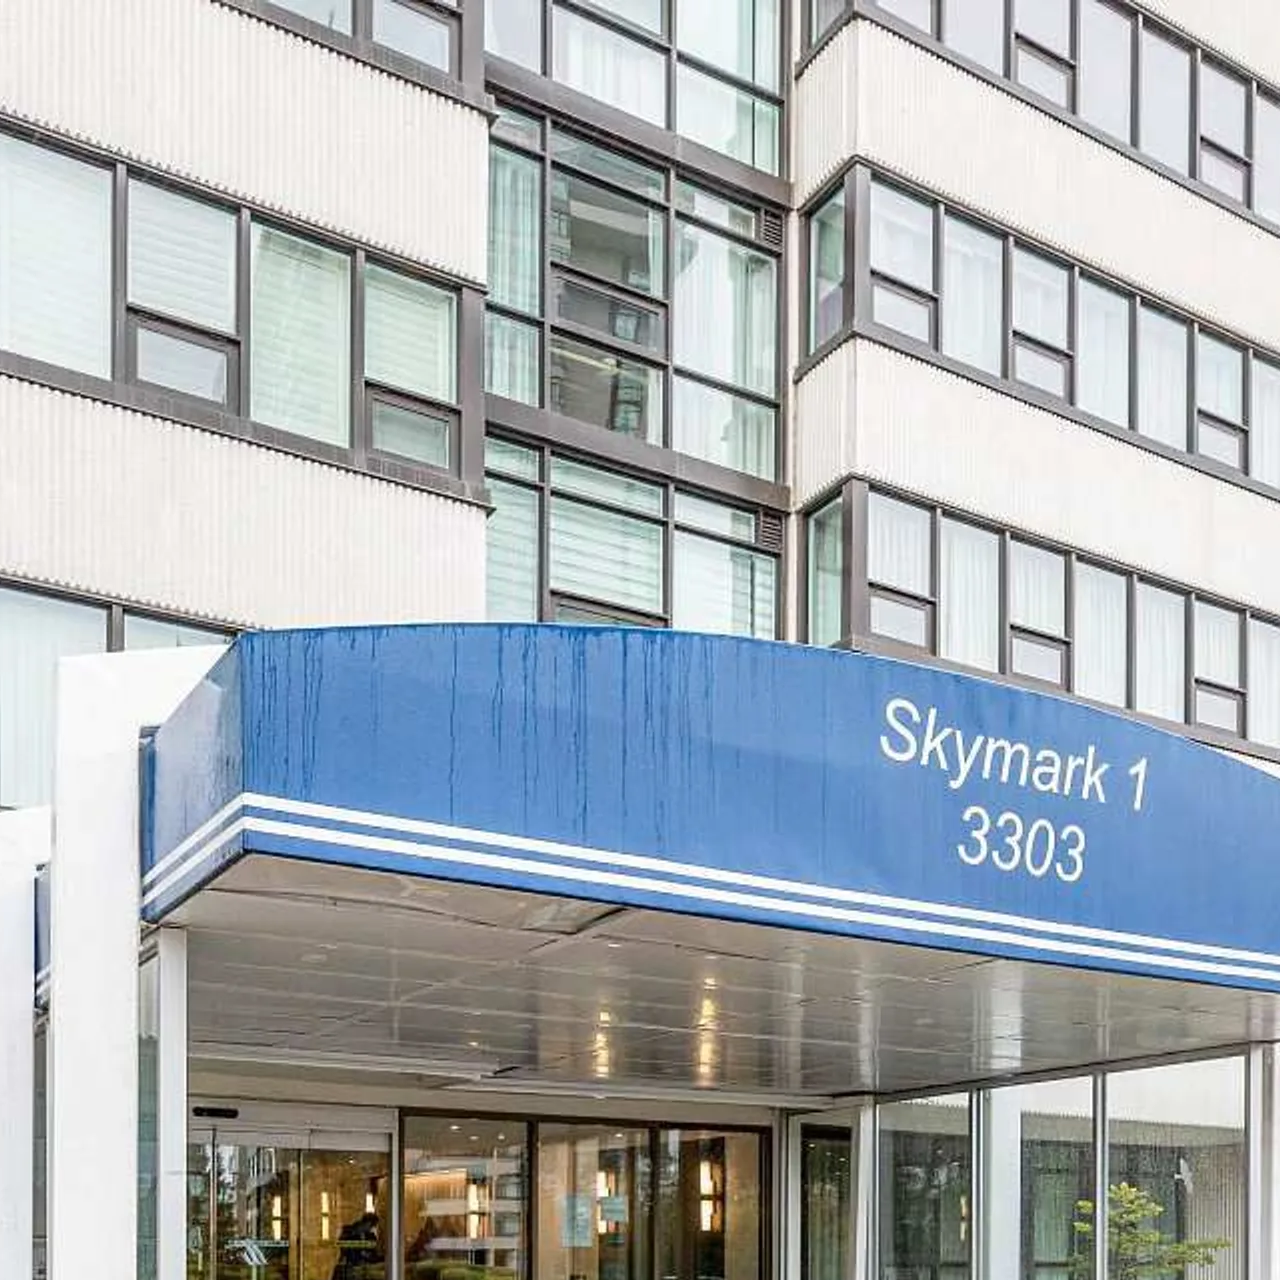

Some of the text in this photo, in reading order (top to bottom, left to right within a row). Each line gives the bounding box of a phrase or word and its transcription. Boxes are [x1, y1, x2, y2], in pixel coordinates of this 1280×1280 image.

[880, 698, 1149, 812] Skymark 1
[957, 805, 1086, 882] 3303
